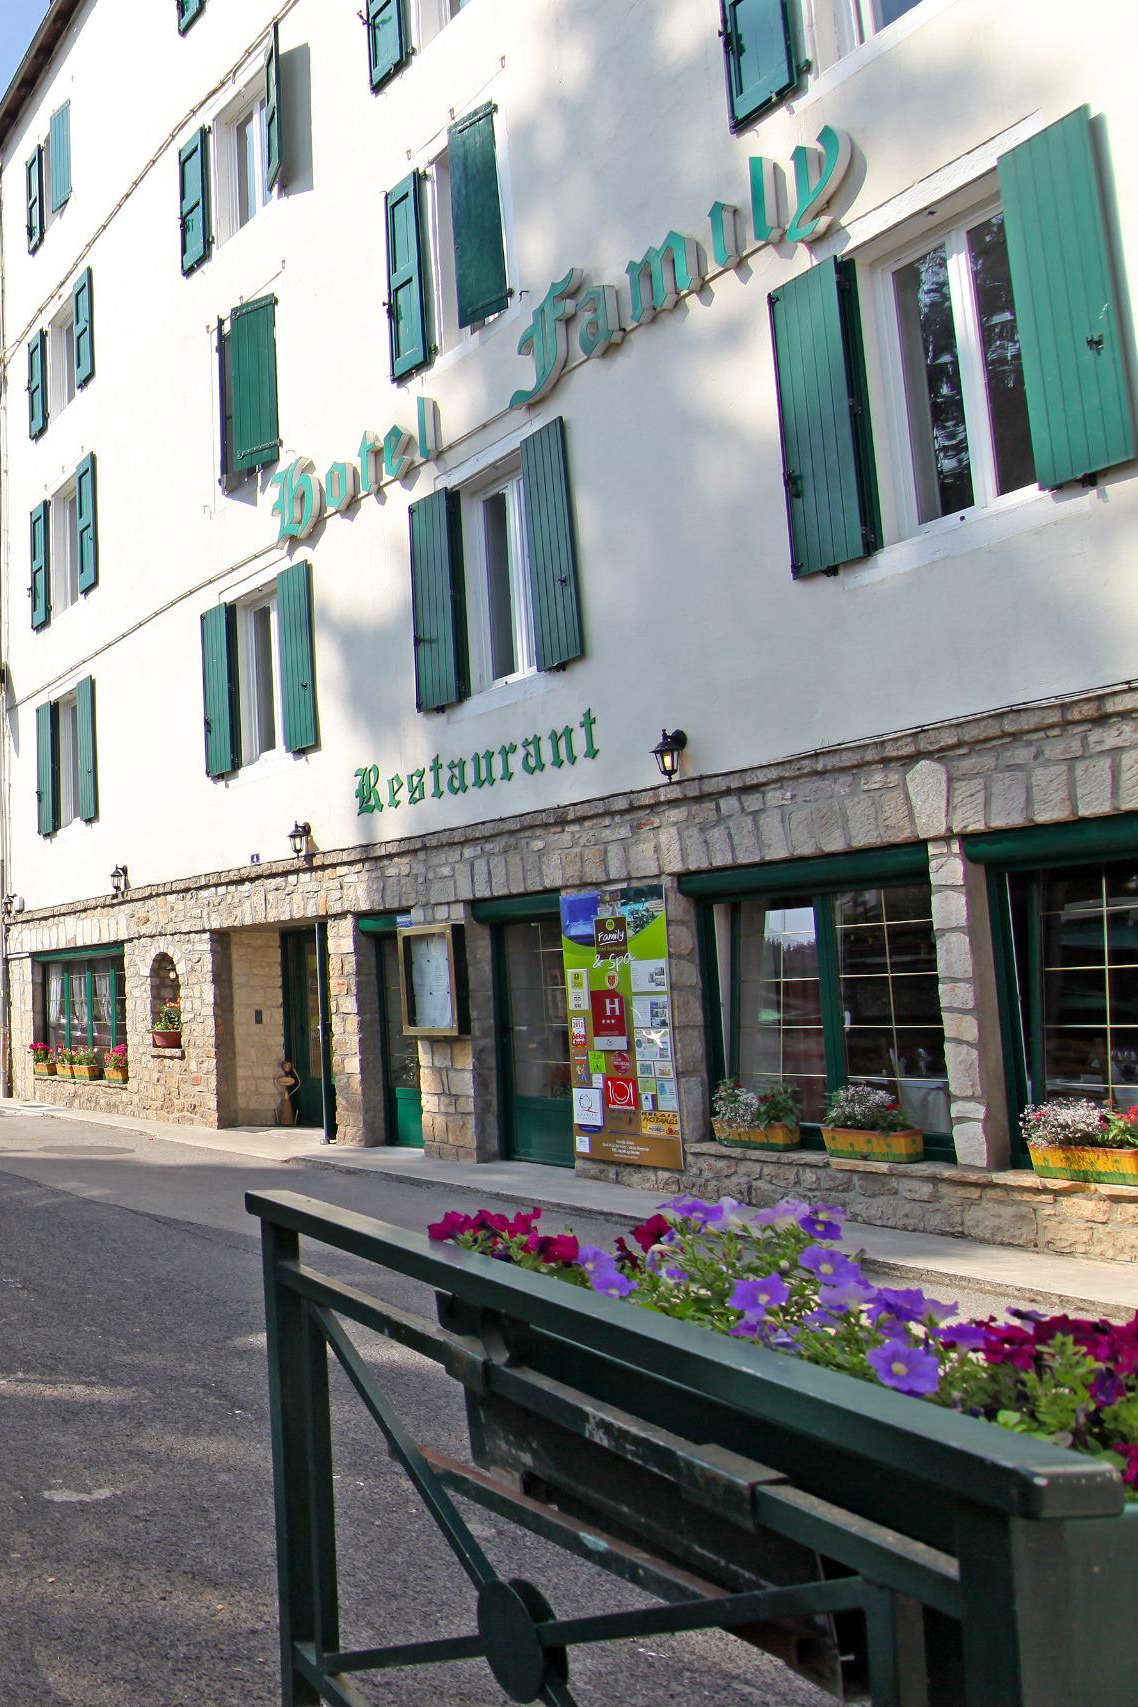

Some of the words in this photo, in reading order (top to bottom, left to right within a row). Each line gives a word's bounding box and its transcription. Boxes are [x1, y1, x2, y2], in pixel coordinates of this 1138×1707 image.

[270, 395, 440, 549] Hotel
[509, 124, 852, 411] Family
[353, 707, 600, 816] Restaurant
[598, 929, 624, 944] Family
[592, 953, 605, 969] &
[607, 952, 636, 971] Spa
[605, 998, 621, 1016] H
